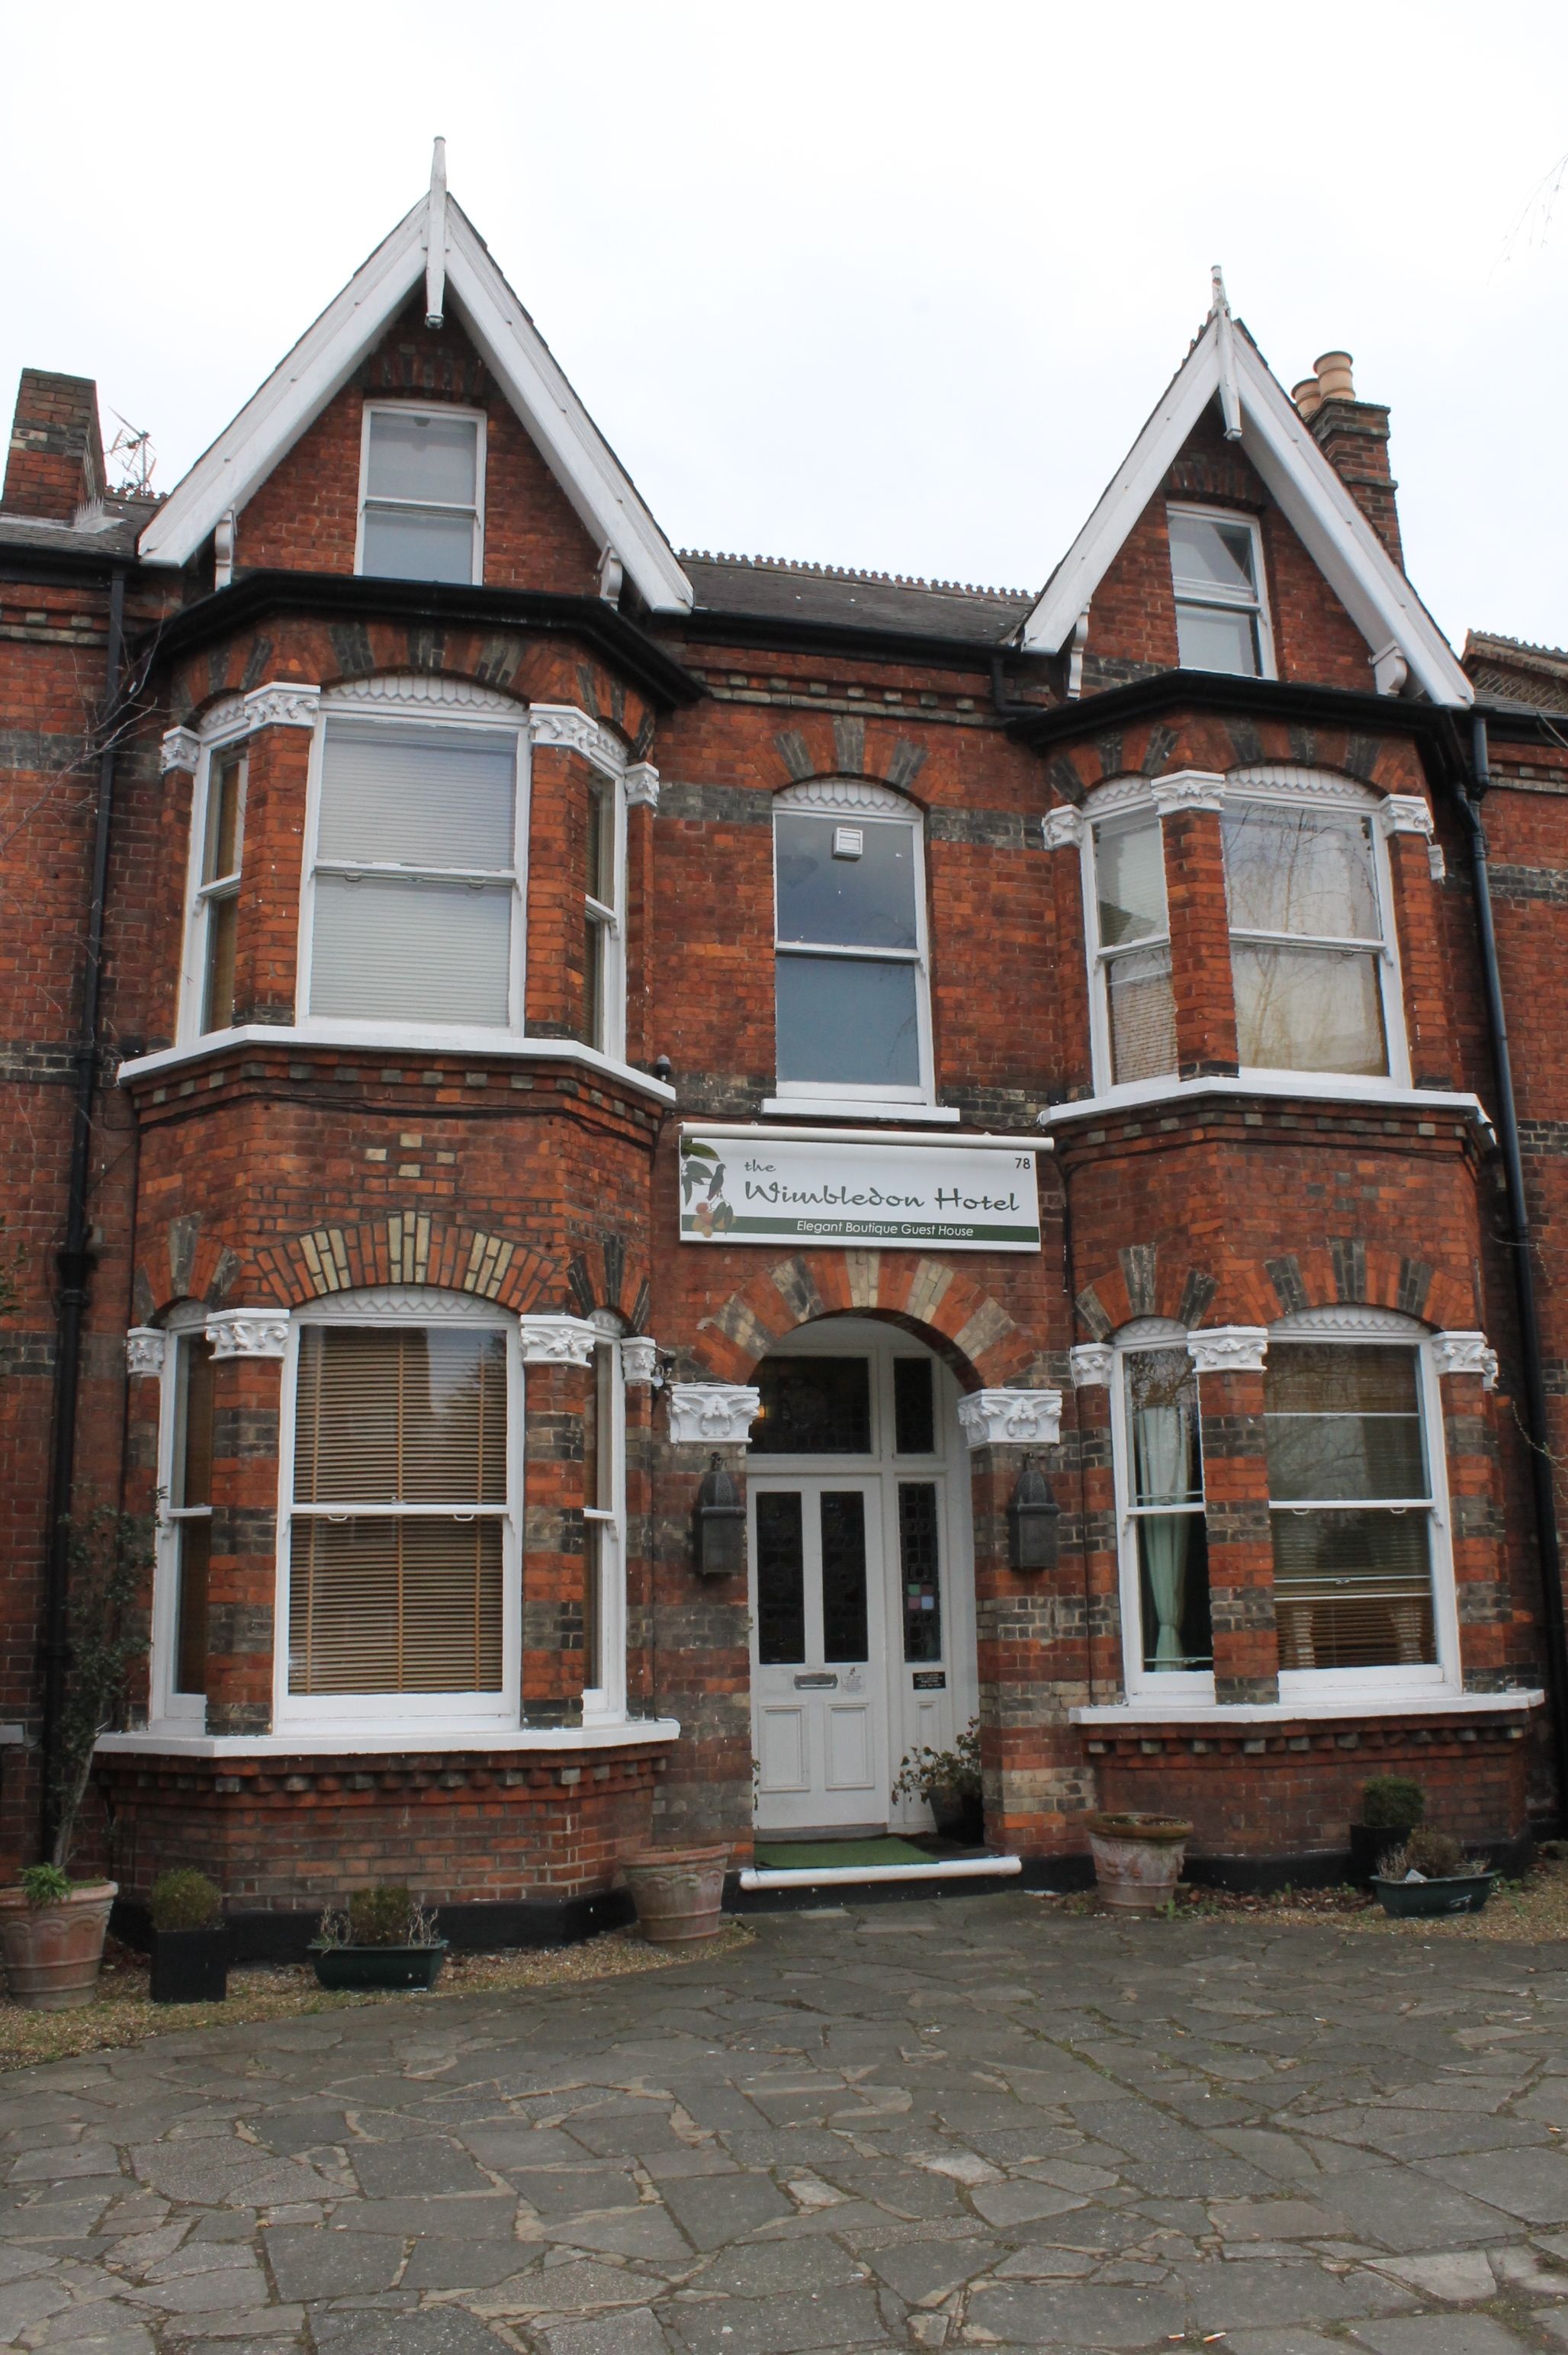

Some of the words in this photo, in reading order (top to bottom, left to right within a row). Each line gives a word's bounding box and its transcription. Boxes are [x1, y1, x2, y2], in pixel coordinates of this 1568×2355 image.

[744, 1158, 776, 1172] the
[1015, 1158, 1031, 1170] 78
[744, 1181, 925, 1208] Wimbledon
[933, 1187, 1020, 1211] Hotel
[797, 1220, 843, 1234] Elegant
[846, 1222, 898, 1235] Boutique
[901, 1223, 936, 1235] Guest
[938, 1225, 974, 1236] House
